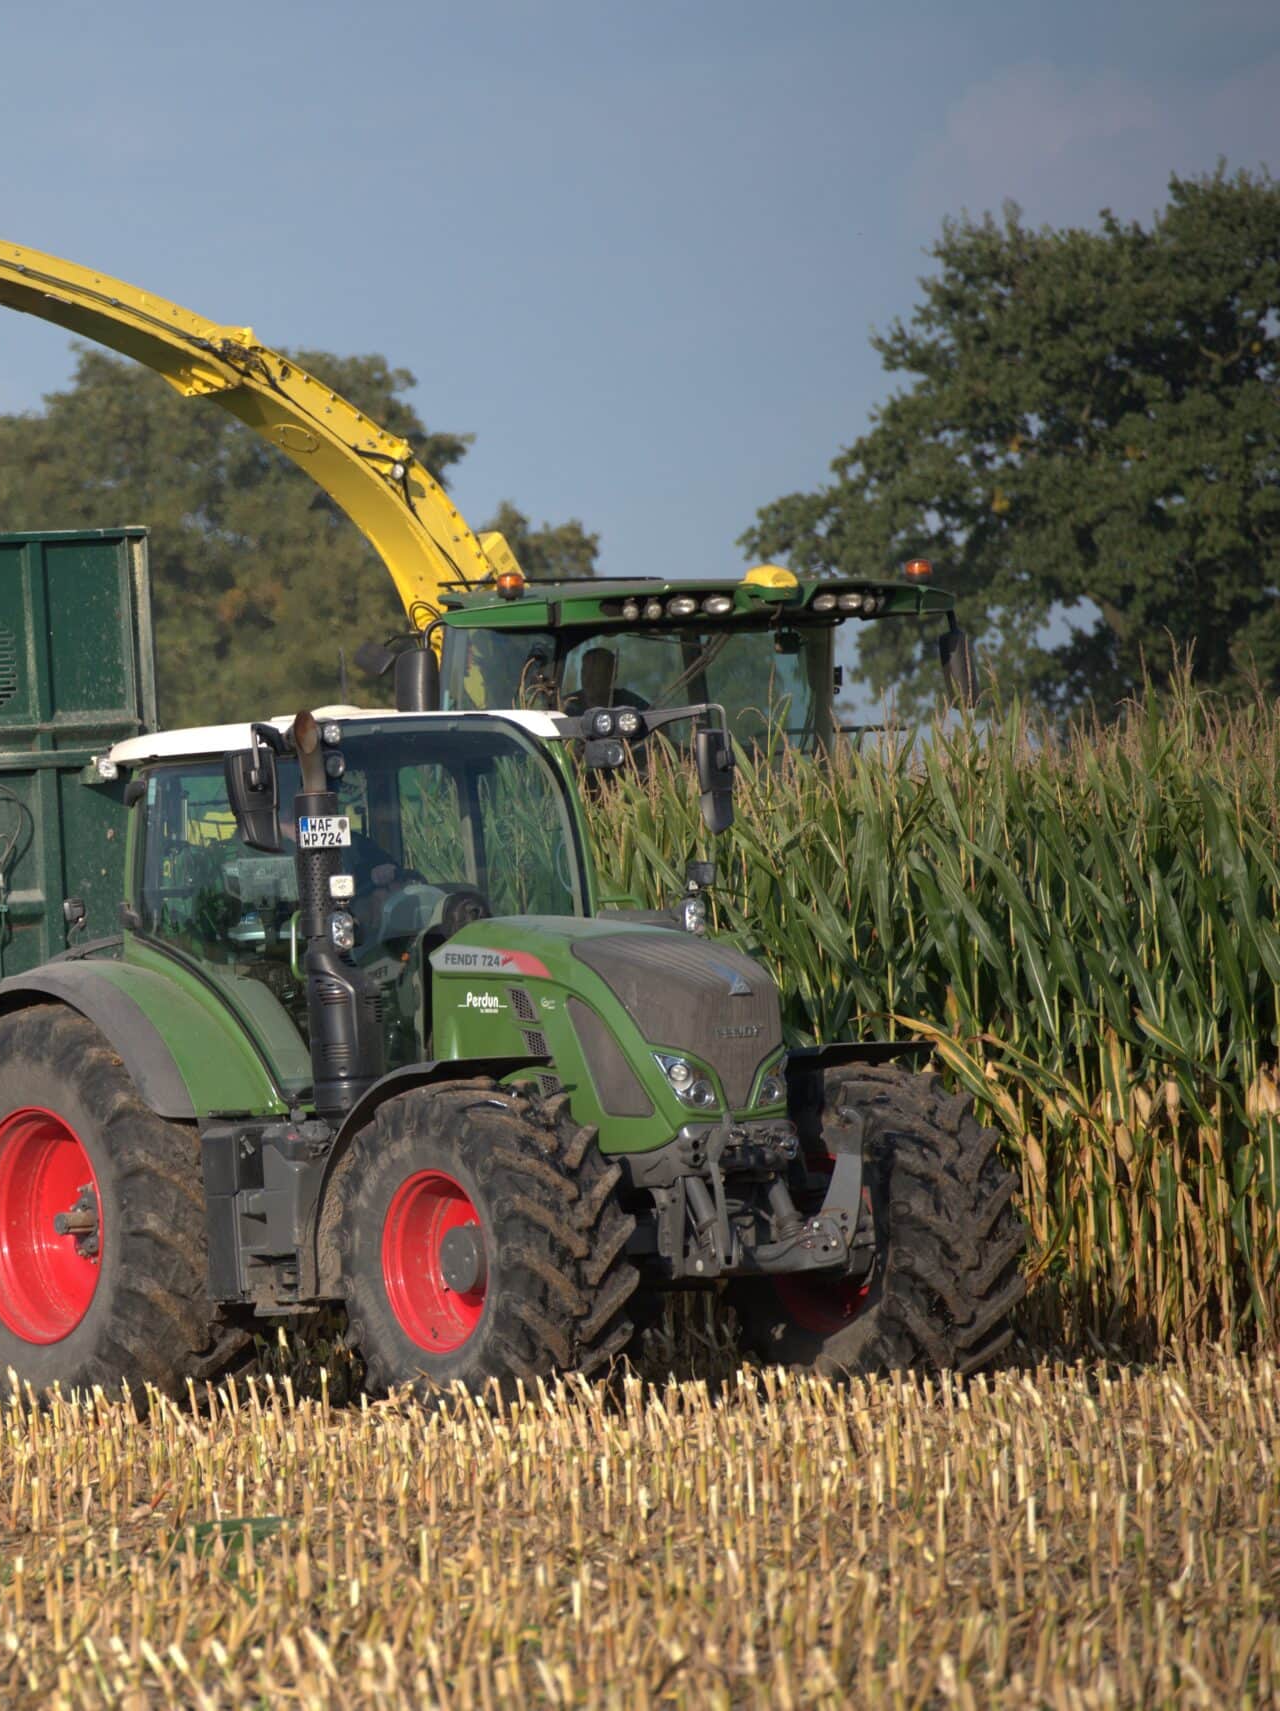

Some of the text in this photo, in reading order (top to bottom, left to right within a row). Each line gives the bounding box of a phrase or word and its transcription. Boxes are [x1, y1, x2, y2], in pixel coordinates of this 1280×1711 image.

[310, 818, 332, 832] WAF
[303, 831, 342, 846] WP 724
[444, 953, 478, 966] FENDT
[482, 954, 500, 967] 724
[466, 991, 499, 1008] Perdun
